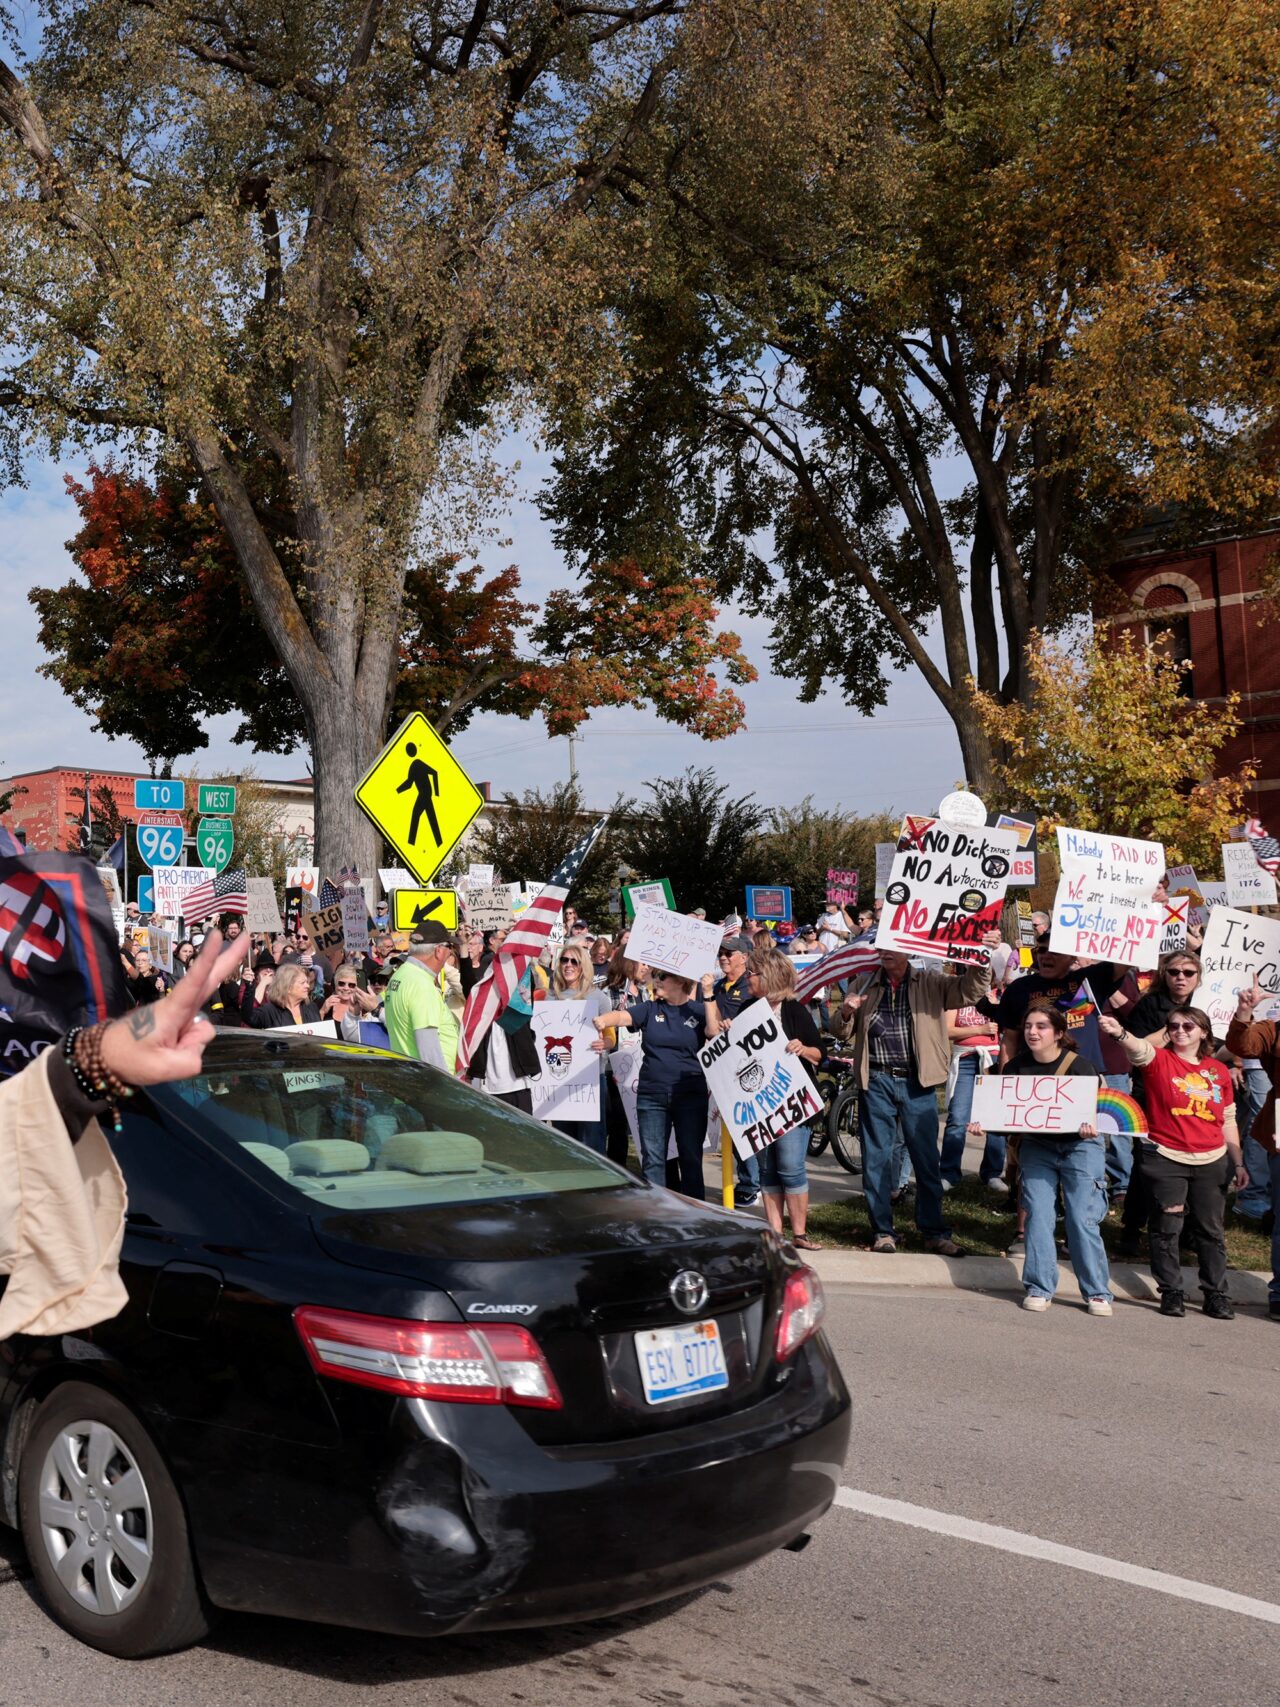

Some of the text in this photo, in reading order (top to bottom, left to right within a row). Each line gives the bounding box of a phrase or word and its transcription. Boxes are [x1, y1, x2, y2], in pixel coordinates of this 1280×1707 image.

[150, 786, 170, 803] TO
[205, 792, 230, 808] WEST
[144, 817, 176, 826] INTERSTATE
[205, 821, 228, 830] BUSINESS
[142, 828, 176, 861] 96
[204, 837, 227, 863] 96
[923, 830, 949, 853] NO
[1067, 834, 1158, 865] Nobody PAID US
[158, 870, 209, 885] PRO-AMERICA
[902, 856, 932, 882] NO
[1097, 862, 1144, 885] to be here
[1170, 866, 1192, 878] TACO
[1069, 874, 1148, 909] We are invested in
[1240, 879, 1261, 887] 1776
[642, 906, 718, 936] STAND UP TO
[1060, 904, 1118, 932] Justice
[1123, 915, 1159, 939] NOT
[1166, 924, 1180, 937] NO
[1075, 931, 1140, 962] PROFIT
[1221, 919, 1265, 955] I've
[641, 941, 689, 967] 25/47
[947, 942, 991, 966] bums
[1205, 955, 1255, 973] Better
[1210, 980, 1223, 994] at
[535, 1011, 552, 1029] I
[701, 1018, 778, 1068] ONLY YOU
[564, 1083, 596, 1104] TIFA
[734, 1060, 792, 1125] CAN PREVENT
[1000, 1076, 1074, 1104] FUCK
[742, 1086, 819, 1153] FACISM
[1004, 1104, 1062, 1129] ICE
[646, 1340, 722, 1385] ESX 8772
